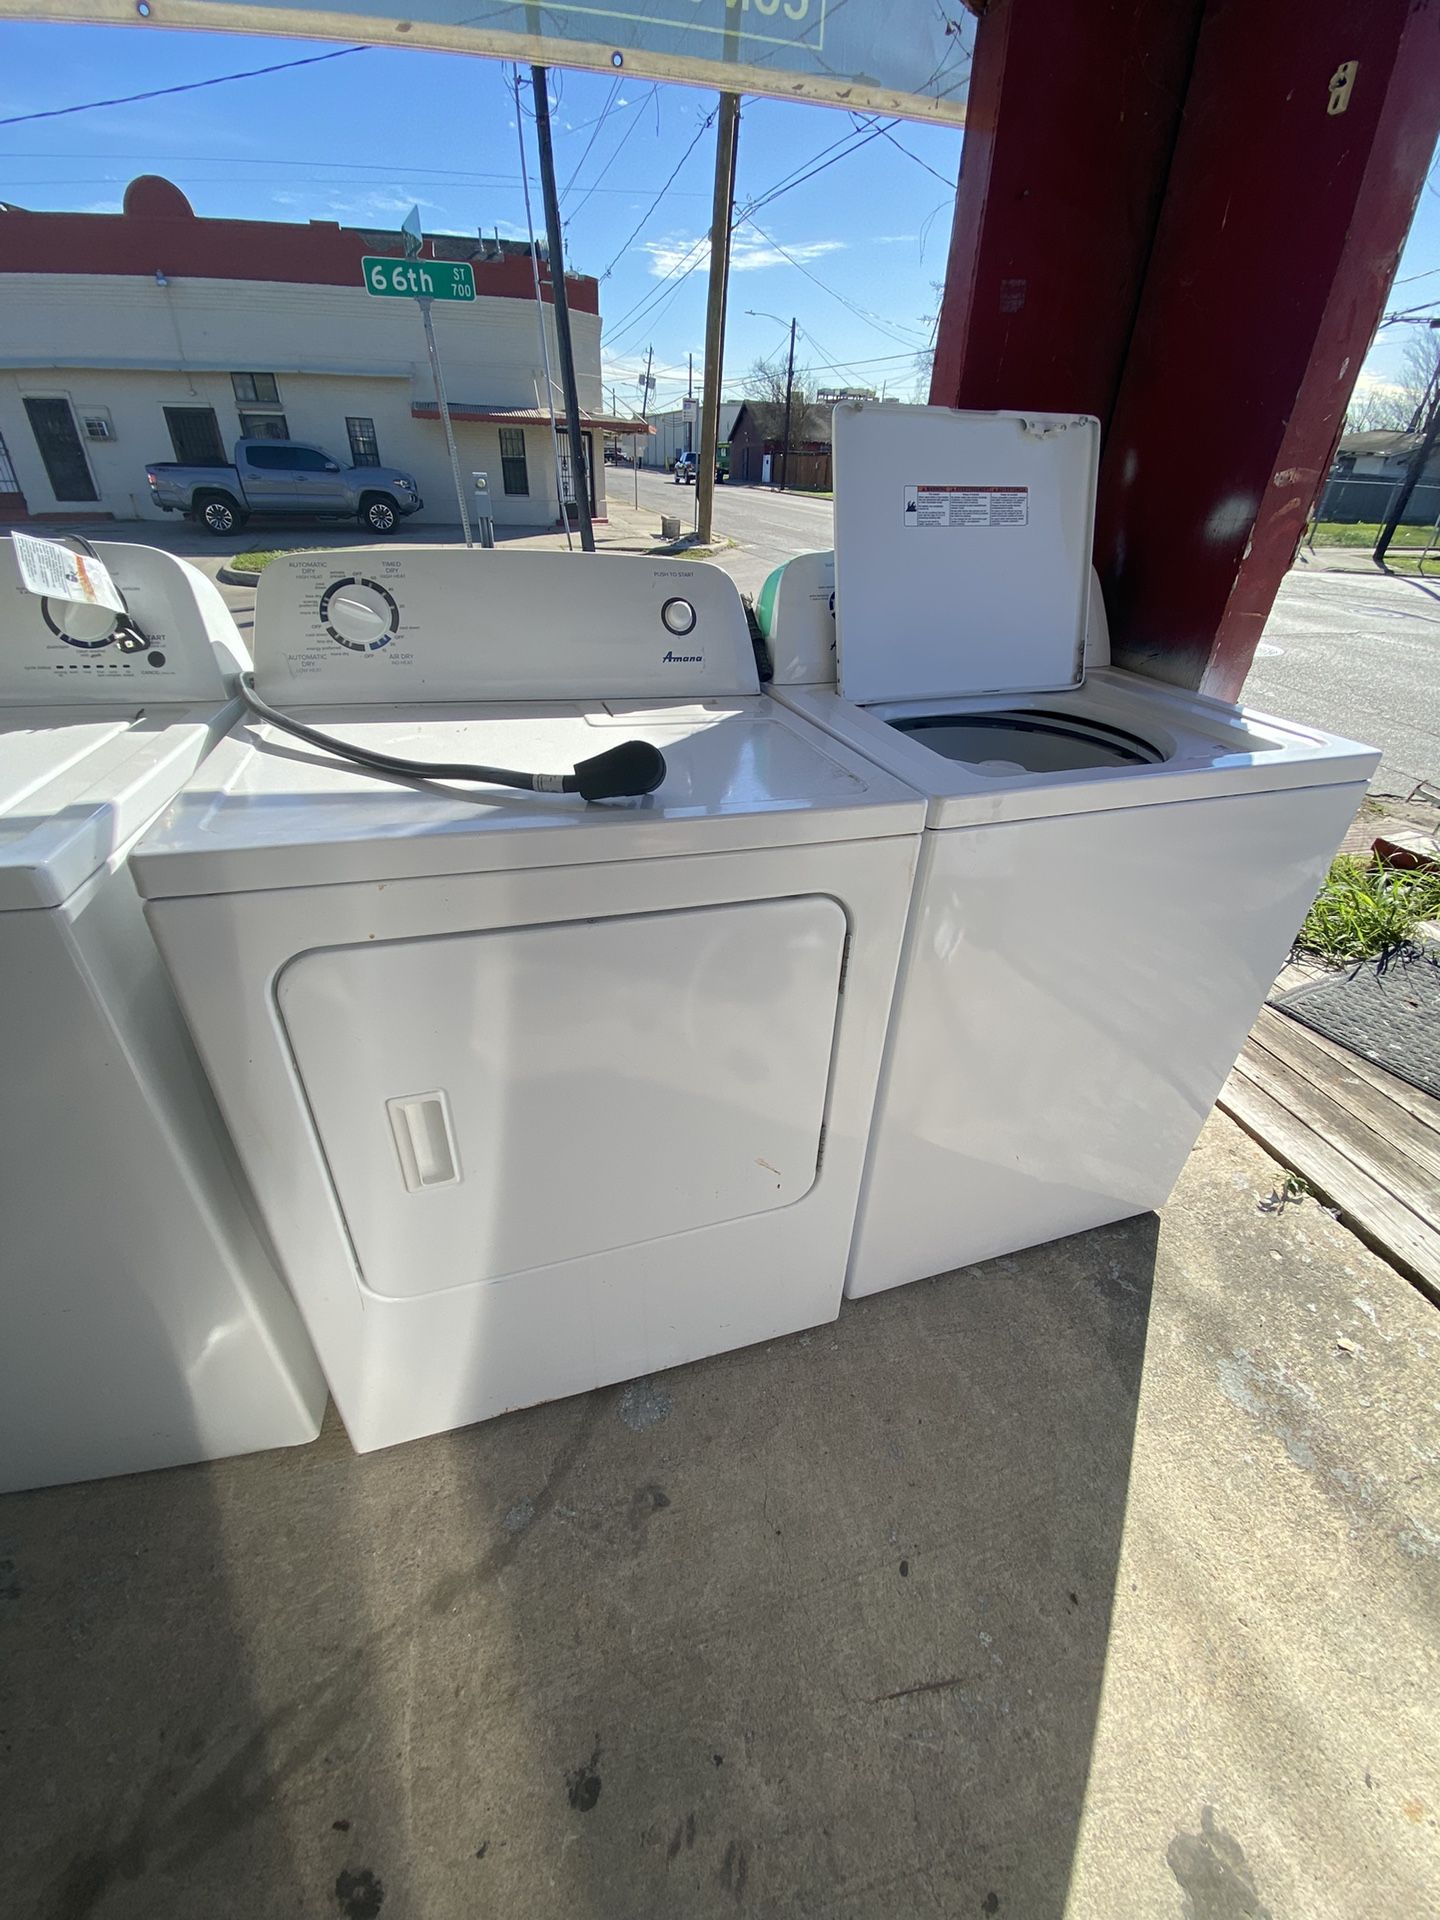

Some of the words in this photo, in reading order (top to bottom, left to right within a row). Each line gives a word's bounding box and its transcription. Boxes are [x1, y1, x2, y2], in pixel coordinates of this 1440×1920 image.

[371, 265, 434, 292] 66th
[453, 267, 465, 281] ST
[451, 284, 471, 297] 700
[662, 650, 703, 663] Amana
